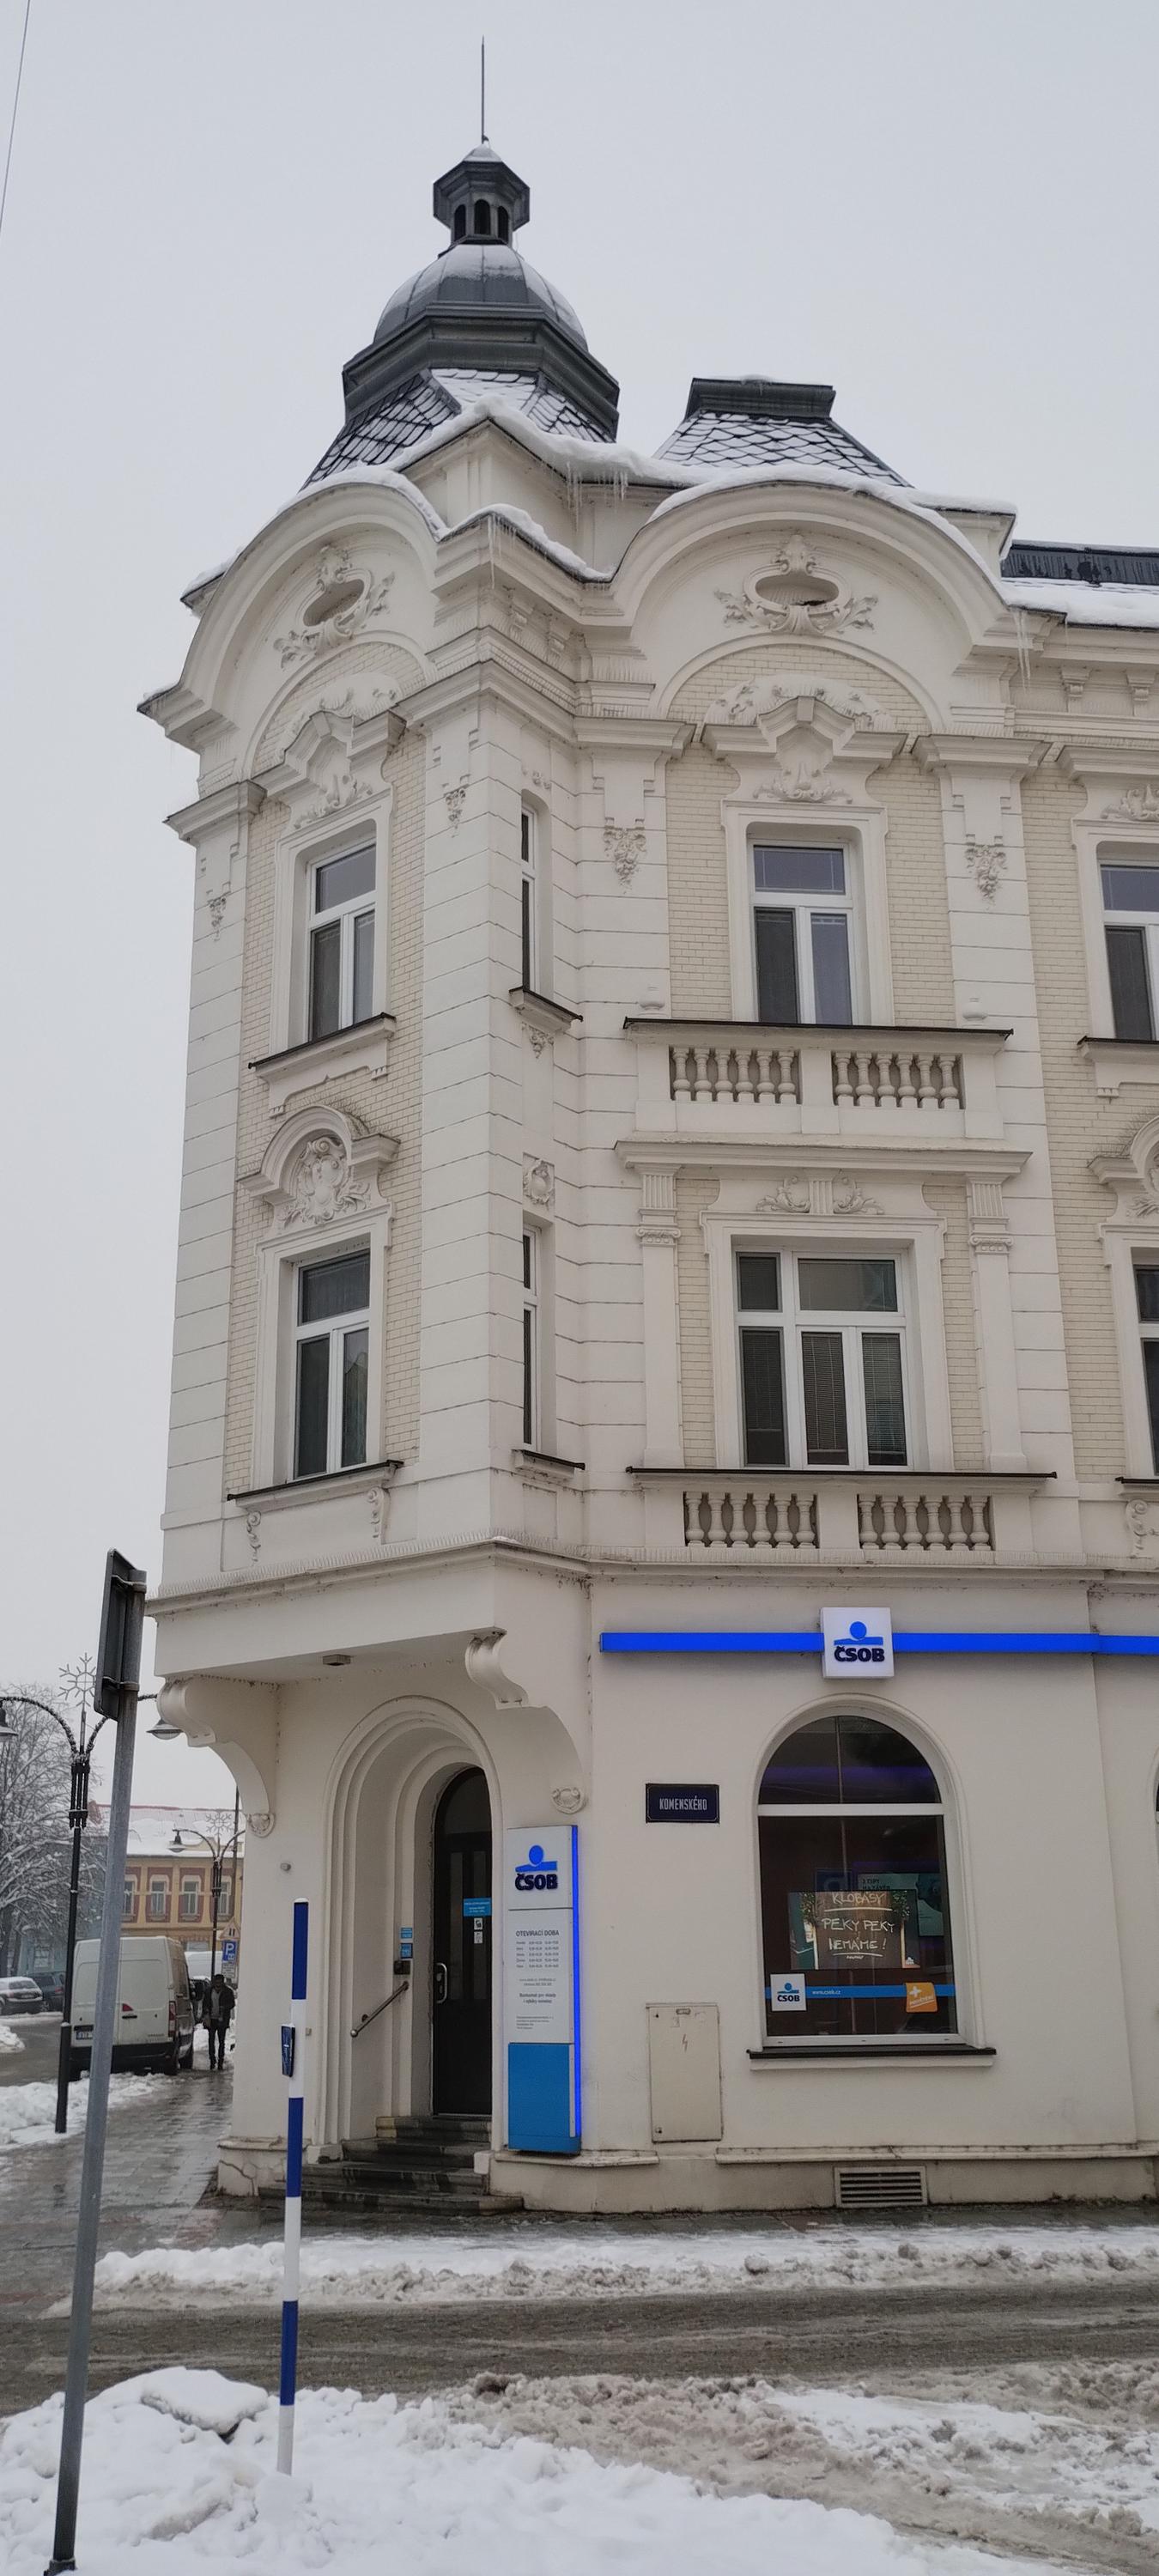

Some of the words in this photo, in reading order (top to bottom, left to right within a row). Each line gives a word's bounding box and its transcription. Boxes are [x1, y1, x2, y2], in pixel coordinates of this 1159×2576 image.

[834, 1645, 885, 1662] ČSOB
[659, 1795, 707, 1811] KOMENSKÉHO
[515, 1873, 558, 1891] ČSOB
[821, 1917, 859, 1932] PEKY
[863, 1919, 895, 1933] PEKY
[226, 1942, 234, 1955] P
